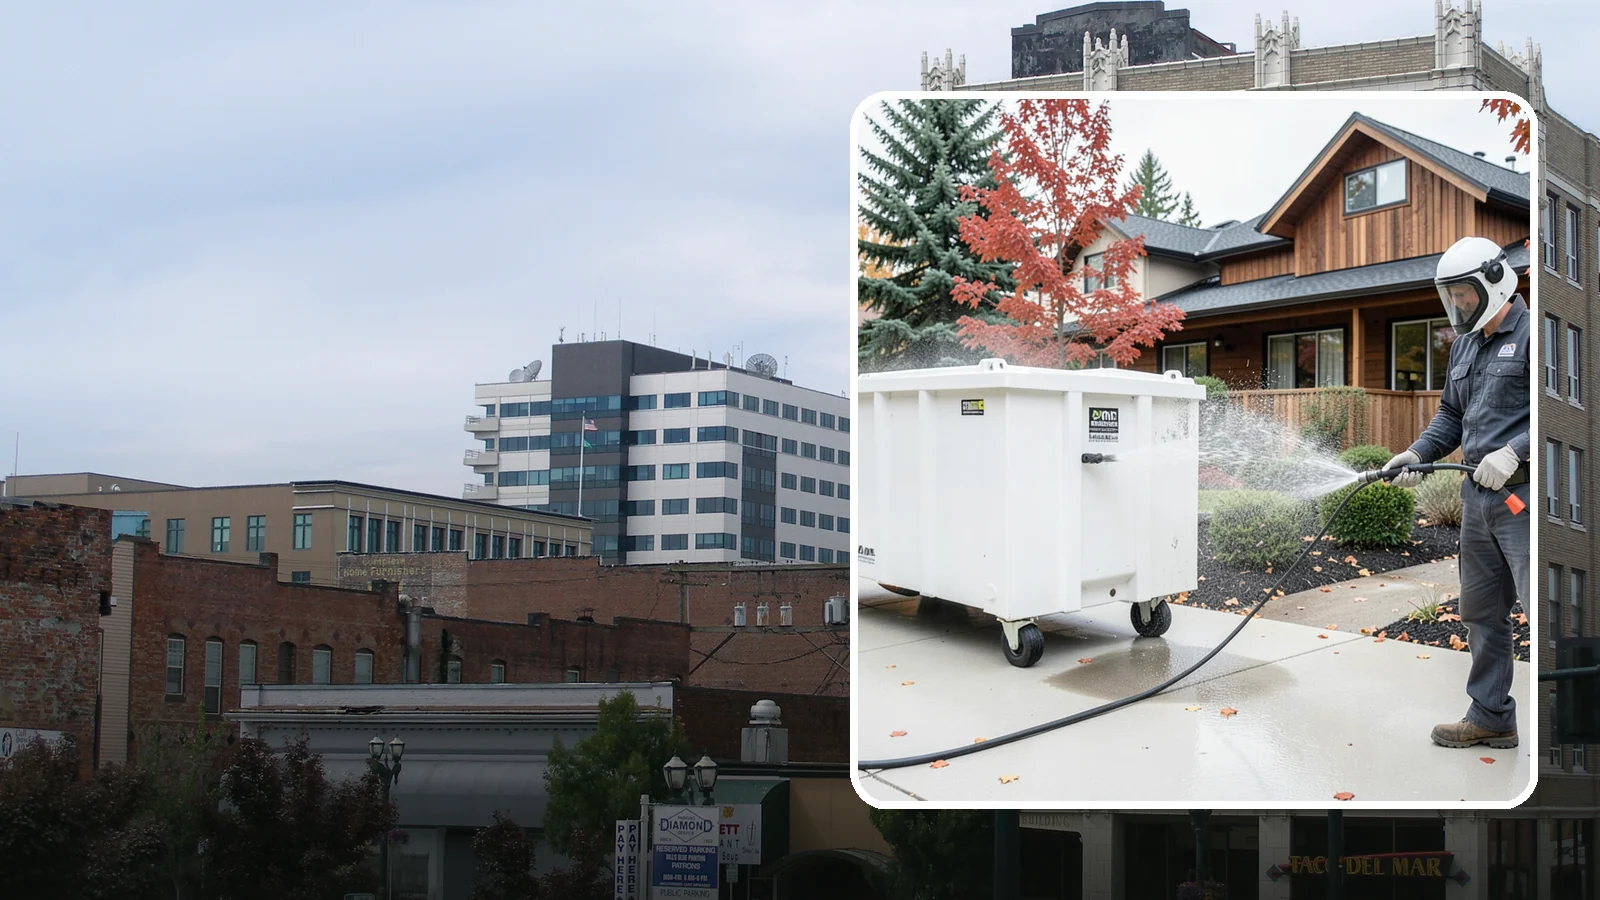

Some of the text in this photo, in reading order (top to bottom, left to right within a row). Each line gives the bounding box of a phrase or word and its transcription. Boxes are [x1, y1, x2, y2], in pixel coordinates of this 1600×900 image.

[343, 567, 427, 577] Home Furnishers
[660, 818, 713, 832] DIAMOND
[1022, 815, 1070, 828] BUILDING
[655, 845, 688, 853] RESERVED
[616, 825, 625, 894] PAY HERE
[627, 824, 636, 893] PAY HERE
[721, 851, 739, 862] Soup
[671, 862, 701, 870] PATRONS
[1345, 856, 1385, 876] DEL
[1392, 857, 1442, 877] MAR
[660, 888, 710, 898] PUBLIC PARKING
